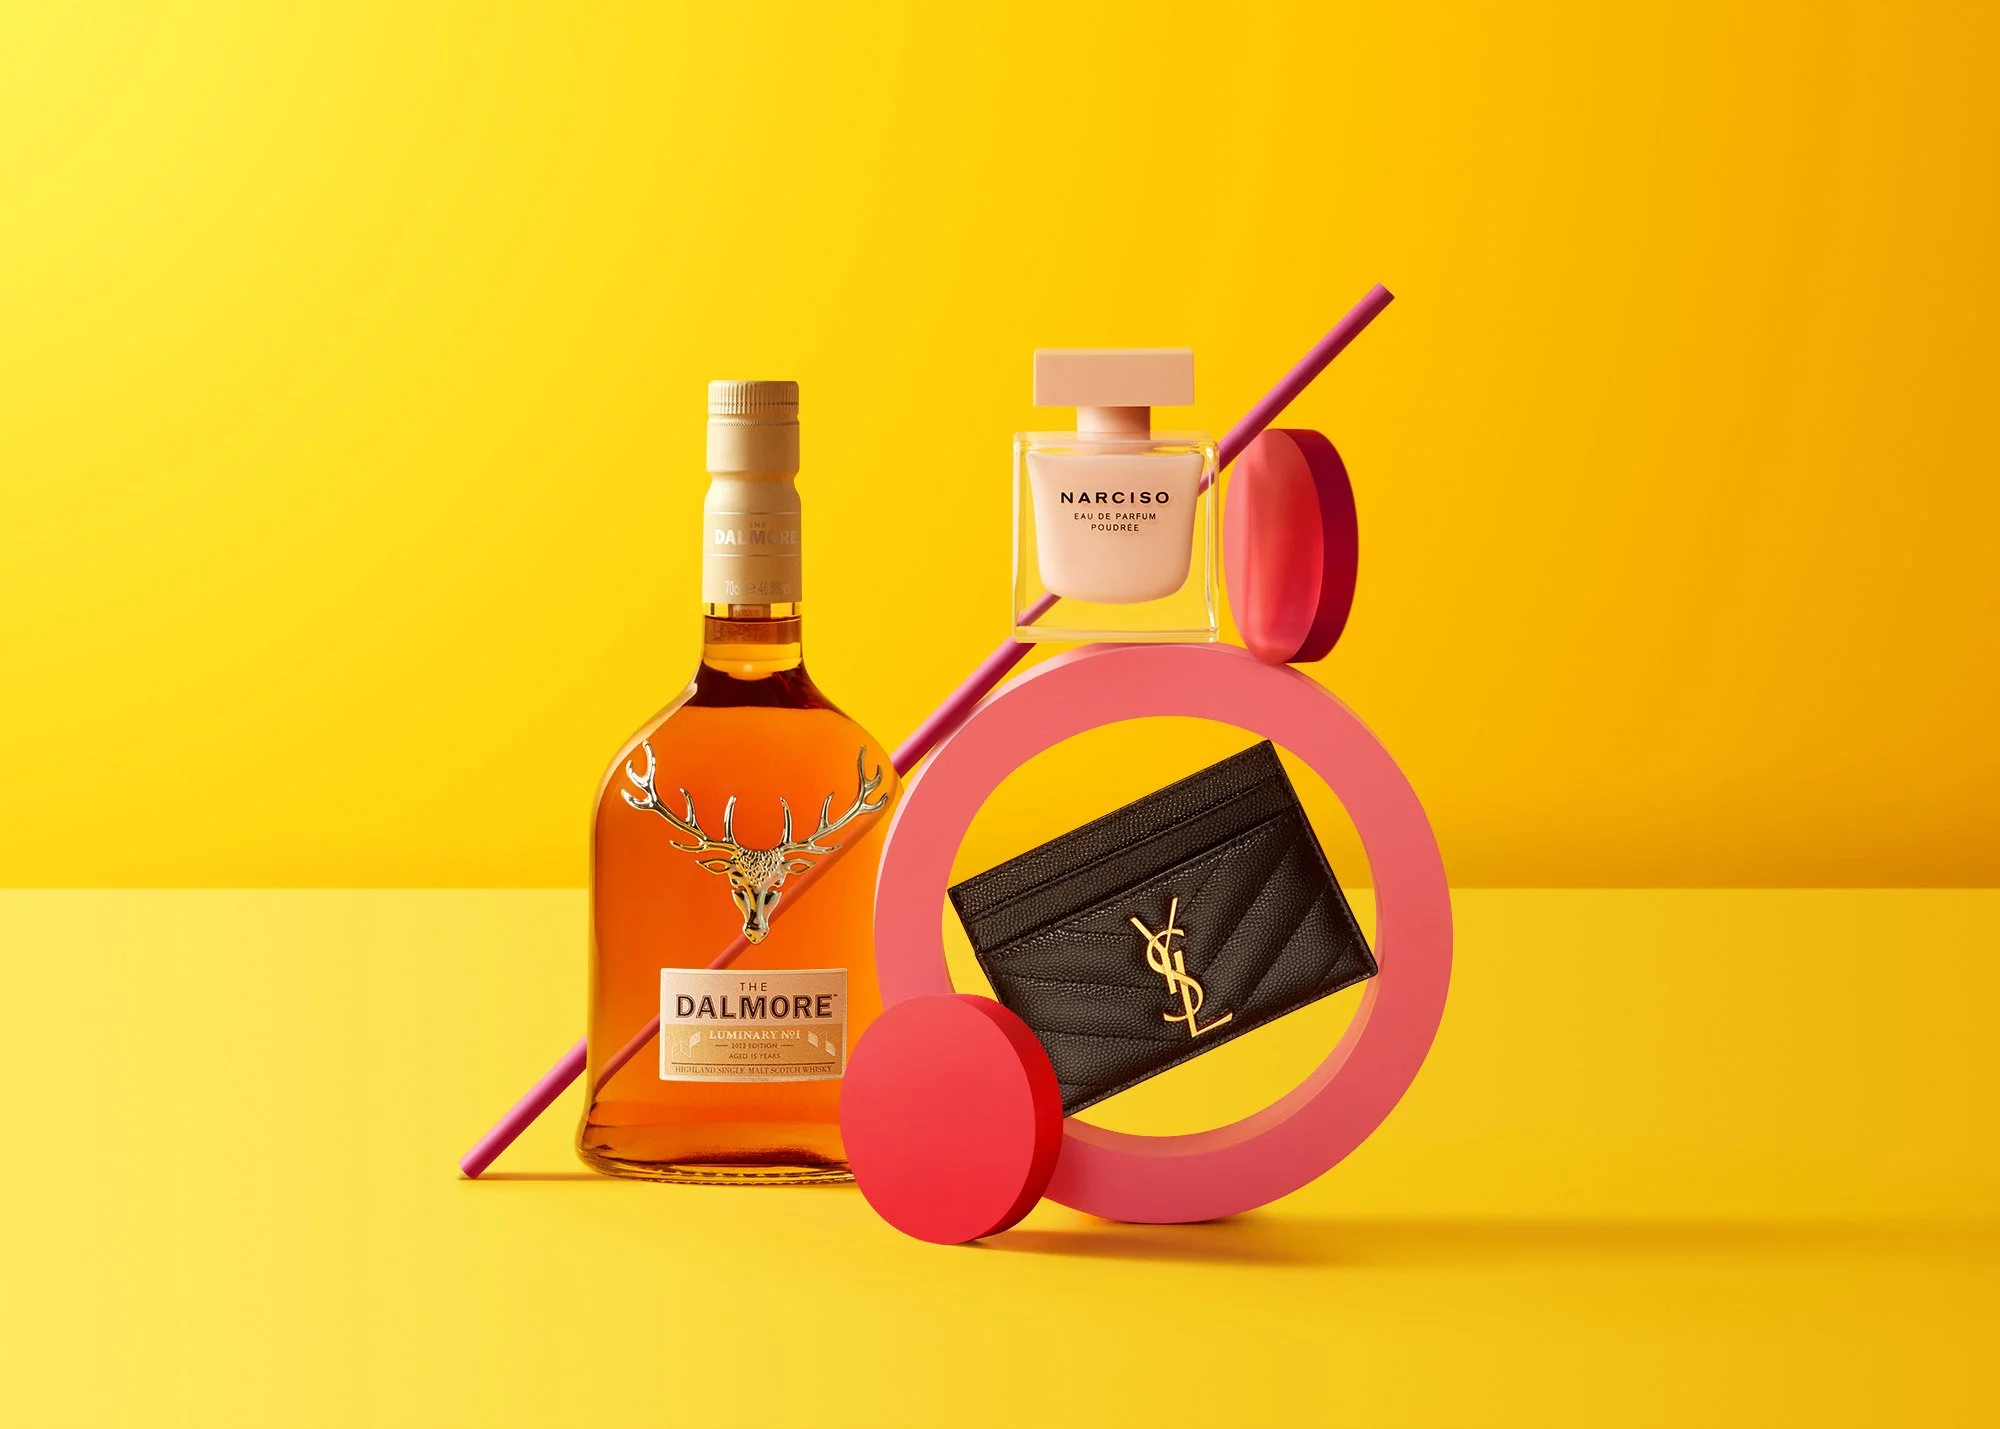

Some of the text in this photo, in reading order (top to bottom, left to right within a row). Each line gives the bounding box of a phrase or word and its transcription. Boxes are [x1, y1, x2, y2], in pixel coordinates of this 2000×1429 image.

[1060, 491, 1170, 504] NARCISO
[1091, 523, 1140, 532] POUDRÉE
[1130, 896, 1233, 1038] YSL
[740, 982, 768, 992] THE
[709, 1030, 778, 1040] LUMINARY
[675, 1065, 833, 1074] HIGHLAND SINGLE MALT SCOTCH WHISKY
